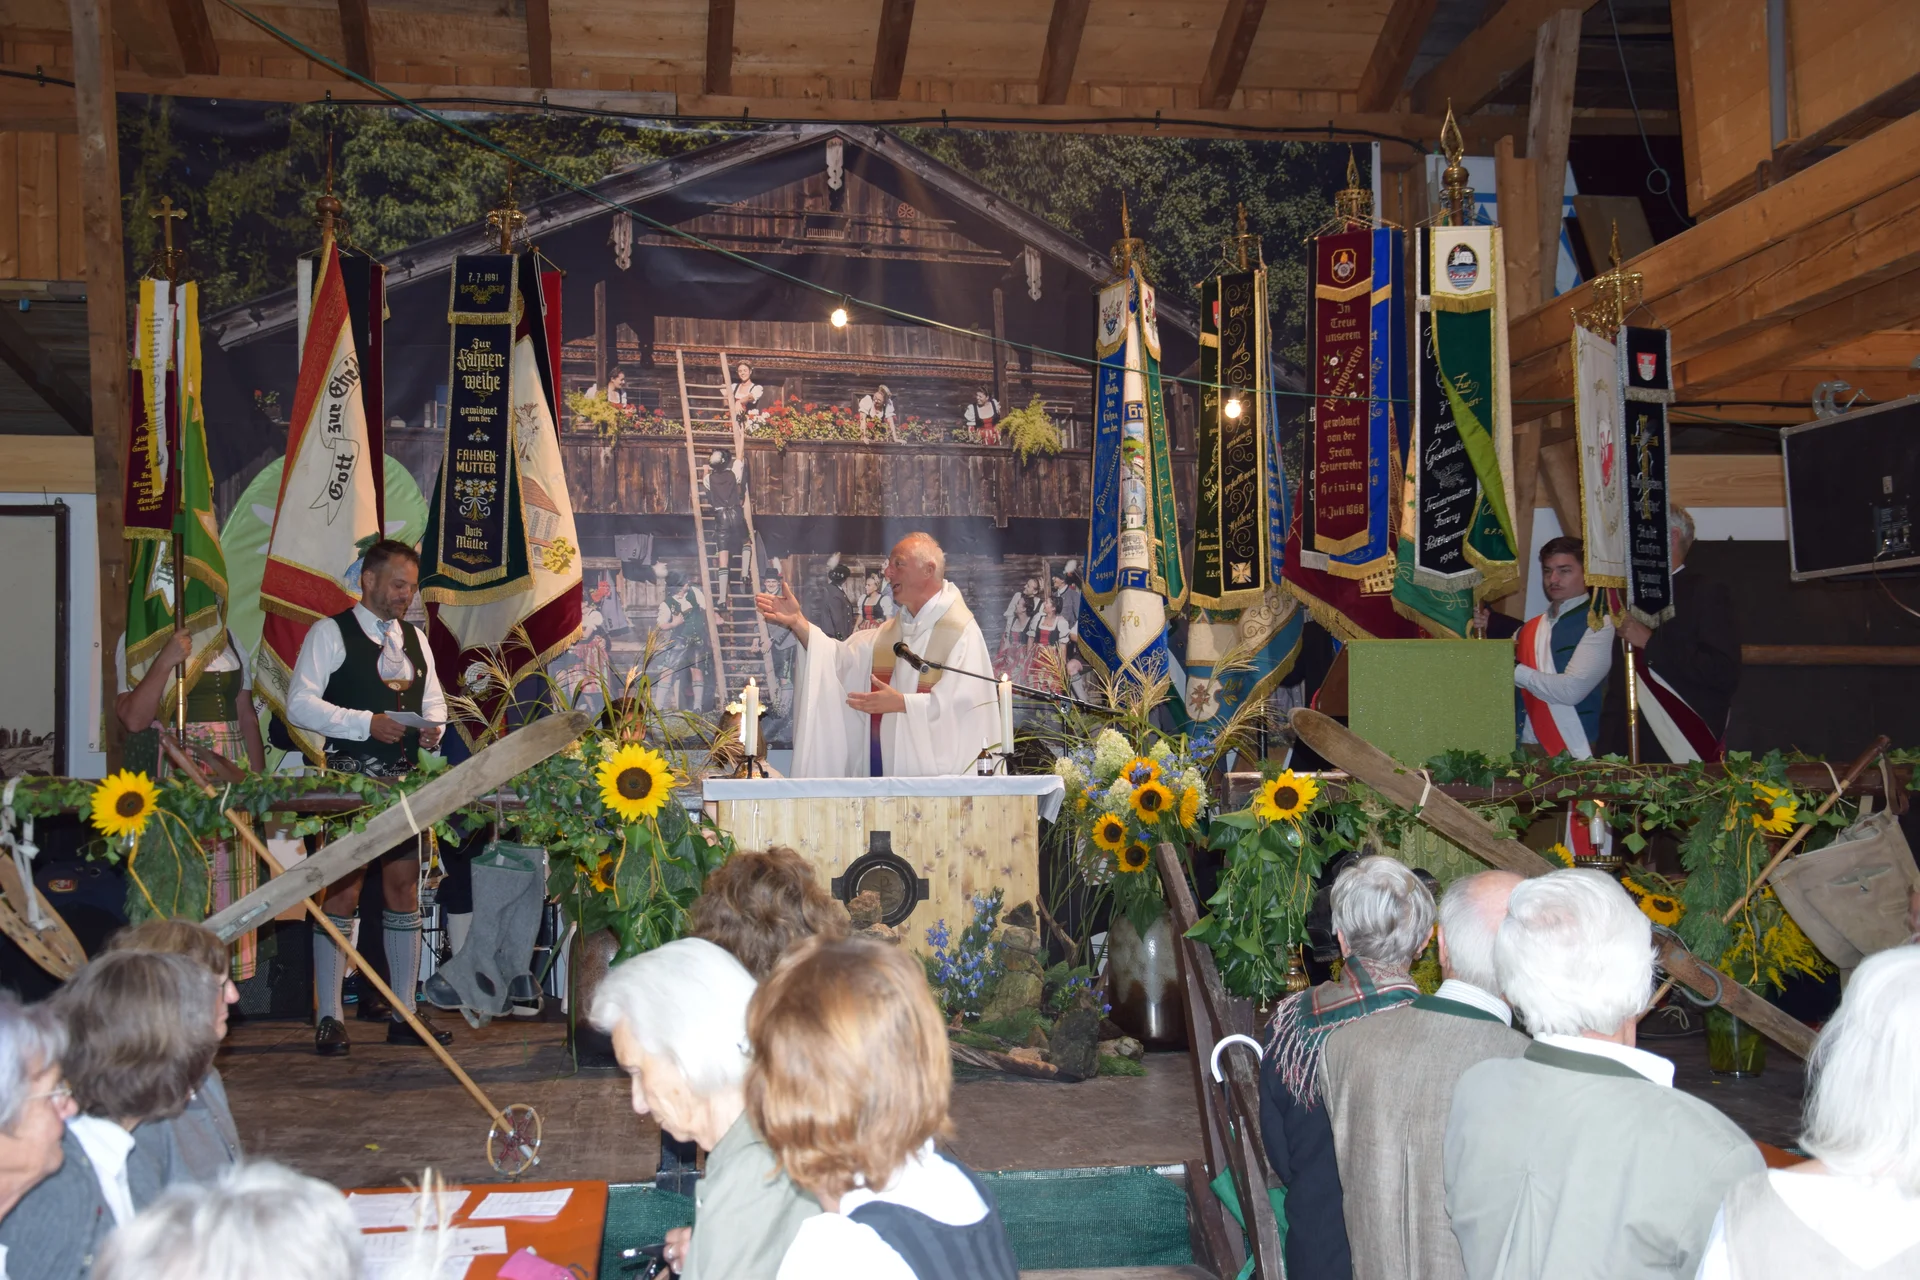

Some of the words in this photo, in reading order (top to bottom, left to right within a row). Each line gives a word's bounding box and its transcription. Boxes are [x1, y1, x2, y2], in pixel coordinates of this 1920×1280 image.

[1337, 303, 1351, 314] In
[1330, 317, 1357, 329] Treue
[472, 337, 491, 349] Zur
[456, 348, 506, 371] Fahnen-
[462, 372, 501, 392] weihe
[460, 406, 498, 416] gewidmet
[328, 404, 342, 434] zur
[1323, 415, 1361, 429] gewidmet
[1327, 433, 1342, 443] von
[1343, 432, 1357, 441] der
[456, 449, 499, 461] FAHNEN-
[456, 461, 497, 474] MUTTER
[1319, 460, 1363, 475] Feuerwehr
[328, 453, 355, 501] Gott
[1321, 482, 1364, 495] Heining
[455, 535, 489, 550] Müller
